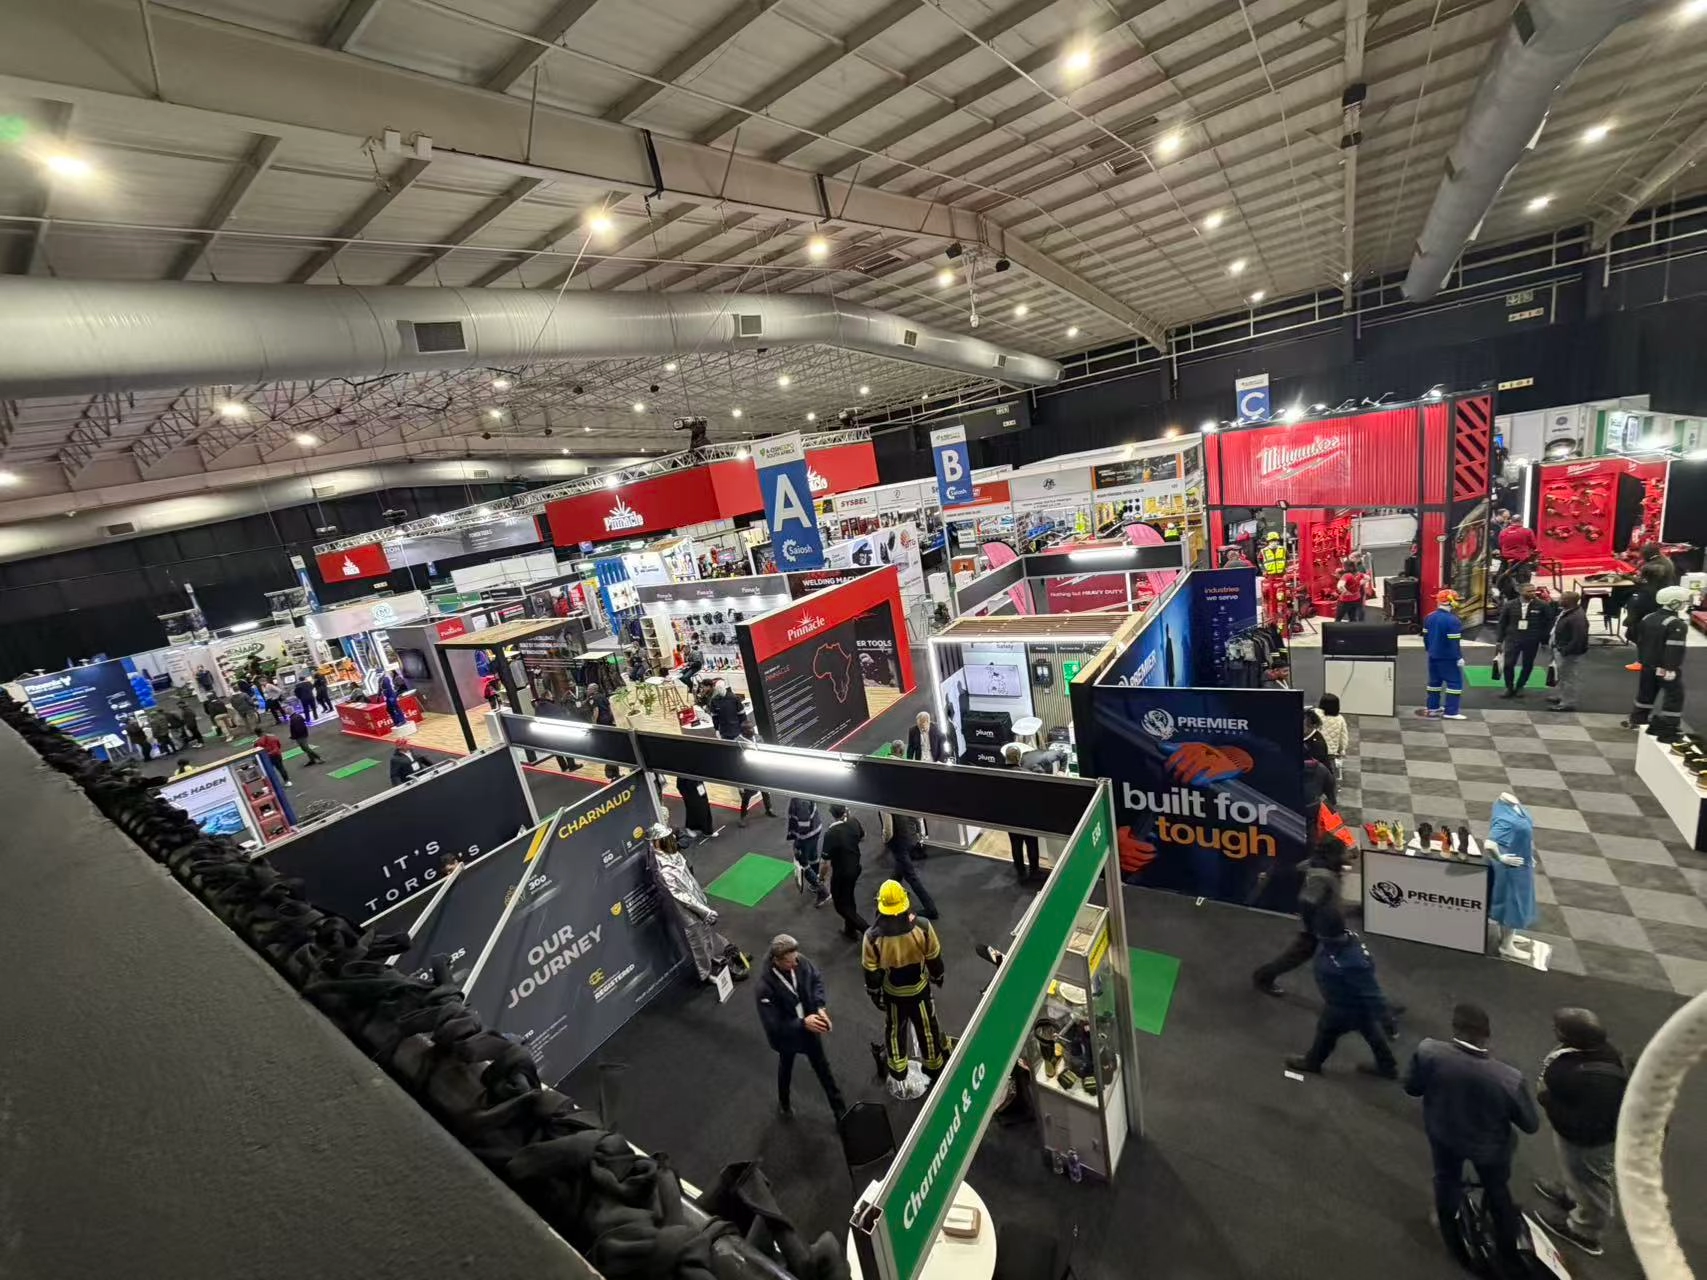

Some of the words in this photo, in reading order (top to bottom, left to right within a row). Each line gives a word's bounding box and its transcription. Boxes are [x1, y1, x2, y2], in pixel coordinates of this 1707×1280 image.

[1240, 391, 1265, 416] C
[941, 449, 963, 482] B
[1257, 436, 1342, 475] Milwaukee
[773, 473, 812, 532] A
[603, 511, 644, 532] Pinnacle
[788, 544, 813, 555] Saiosh
[803, 577, 835, 587] WELDING
[787, 616, 825, 640] Pinnacle
[976, 729, 994, 737] plum
[1178, 716, 1249, 730] PREMIER
[190, 777, 227, 795] HADEN
[1123, 782, 1206, 818] built
[1213, 792, 1280, 825] for
[1154, 816, 1276, 859] tough
[382, 841, 440, 878] IT'S
[602, 853, 614, 864] 60
[365, 844, 480, 911] TORG'S
[528, 874, 547, 890] 300
[1407, 890, 1482, 910] PREMIER
[527, 924, 575, 966] OUR
[508, 924, 602, 1009] JOURNEY
[594, 963, 635, 1000] REGISTERED
[903, 1104, 961, 1230] Charnaud
[962, 1087, 971, 1113] &
[972, 1063, 985, 1090] Co
